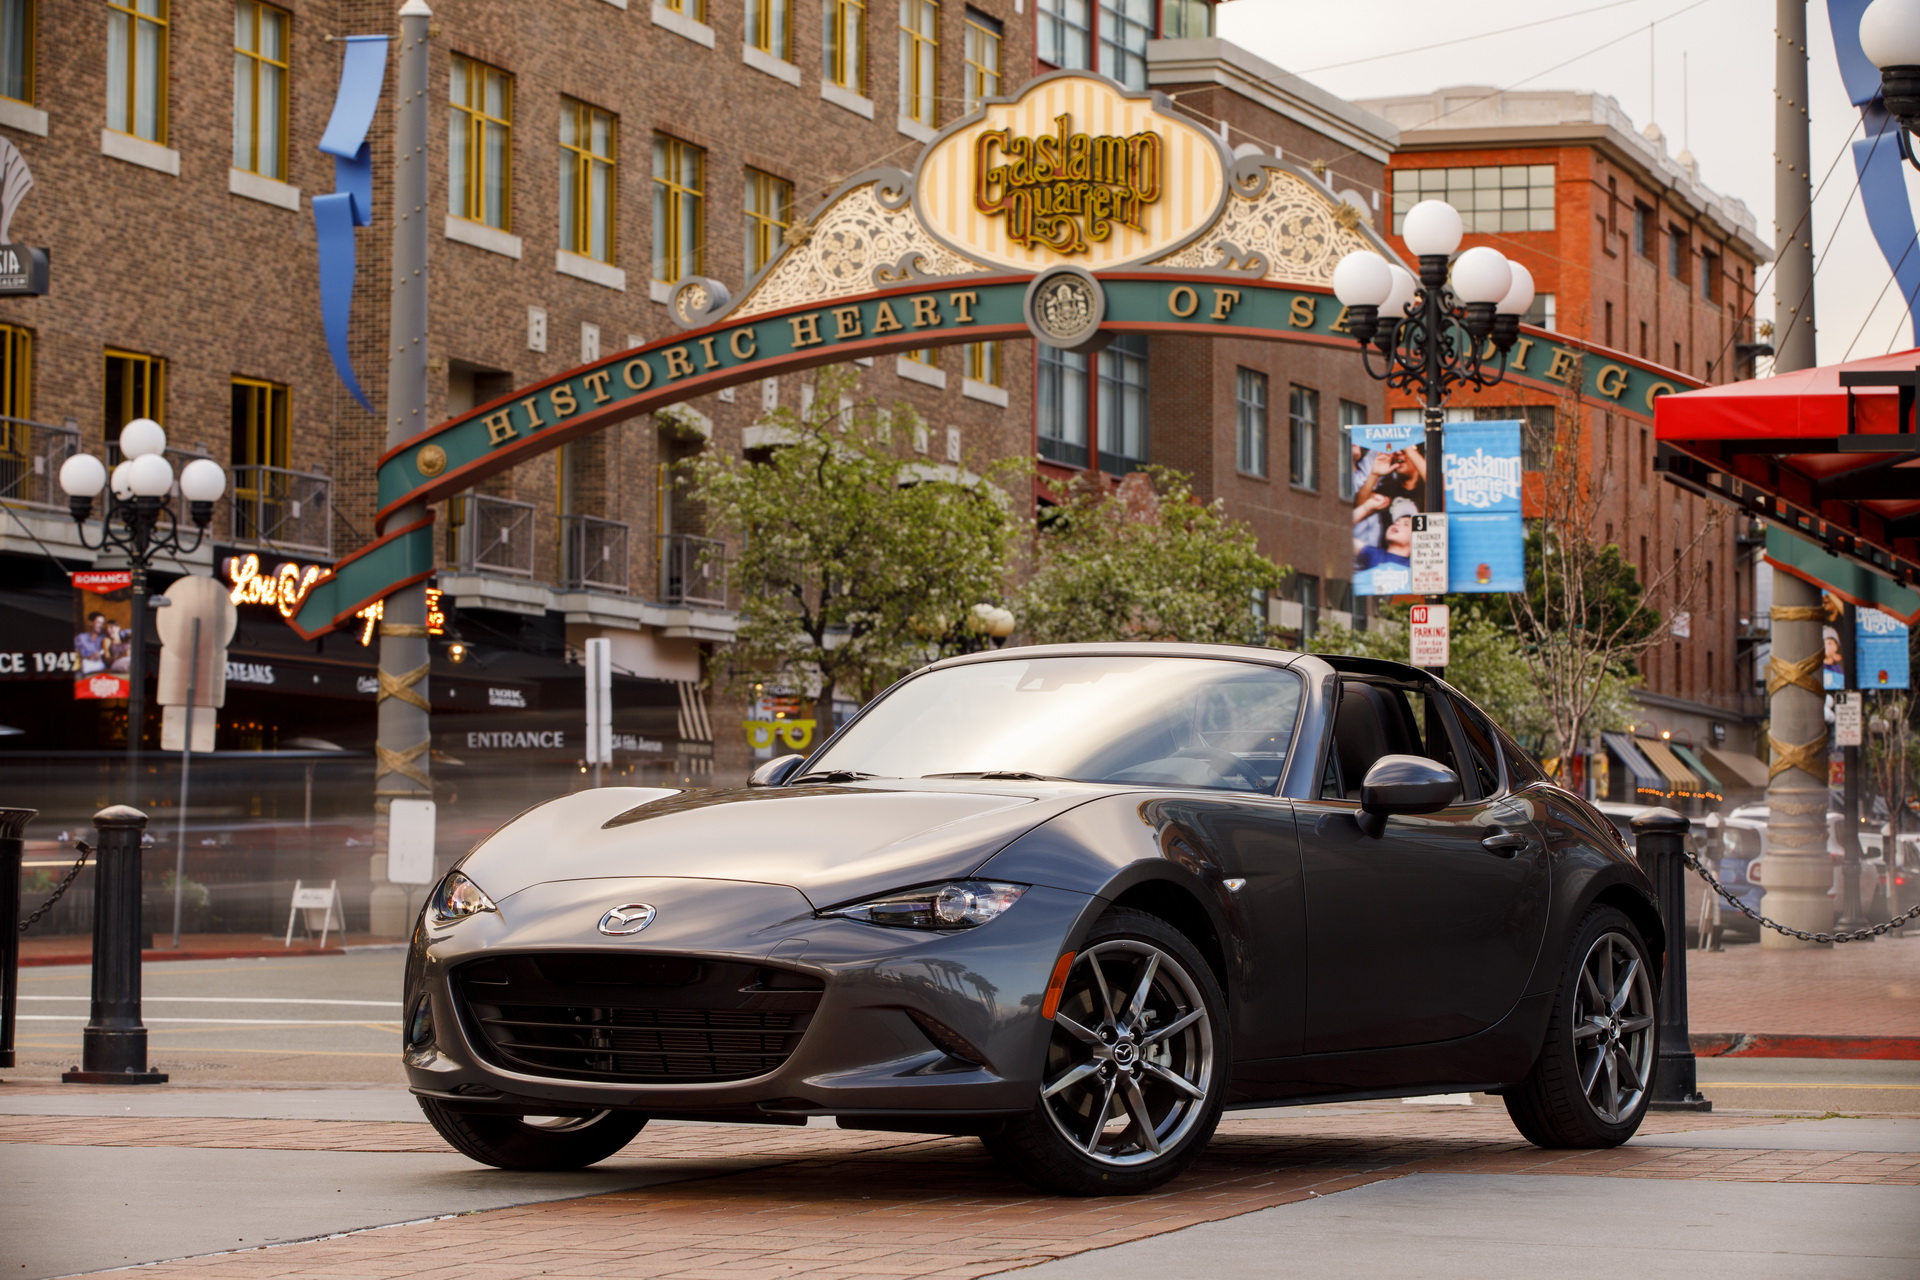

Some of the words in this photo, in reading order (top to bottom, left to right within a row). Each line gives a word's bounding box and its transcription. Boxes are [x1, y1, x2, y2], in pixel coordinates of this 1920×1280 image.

[974, 113, 1163, 220] Gaslamp
[1003, 181, 1146, 254] Quarter
[481, 327, 757, 447] HISTORIC
[787, 291, 978, 348] HEART
[1168, 286, 1240, 320] OF
[1365, 427, 1412, 440] FAMILY
[1444, 448, 1521, 488] Gaslamp
[1416, 516, 1424, 531] 3
[75, 574, 130, 584] ROMANCE
[222, 553, 277, 606] Lou
[1413, 607, 1427, 623] NO
[1413, 626, 1446, 638] PARKING
[467, 731, 565, 749] ENTRANCE
